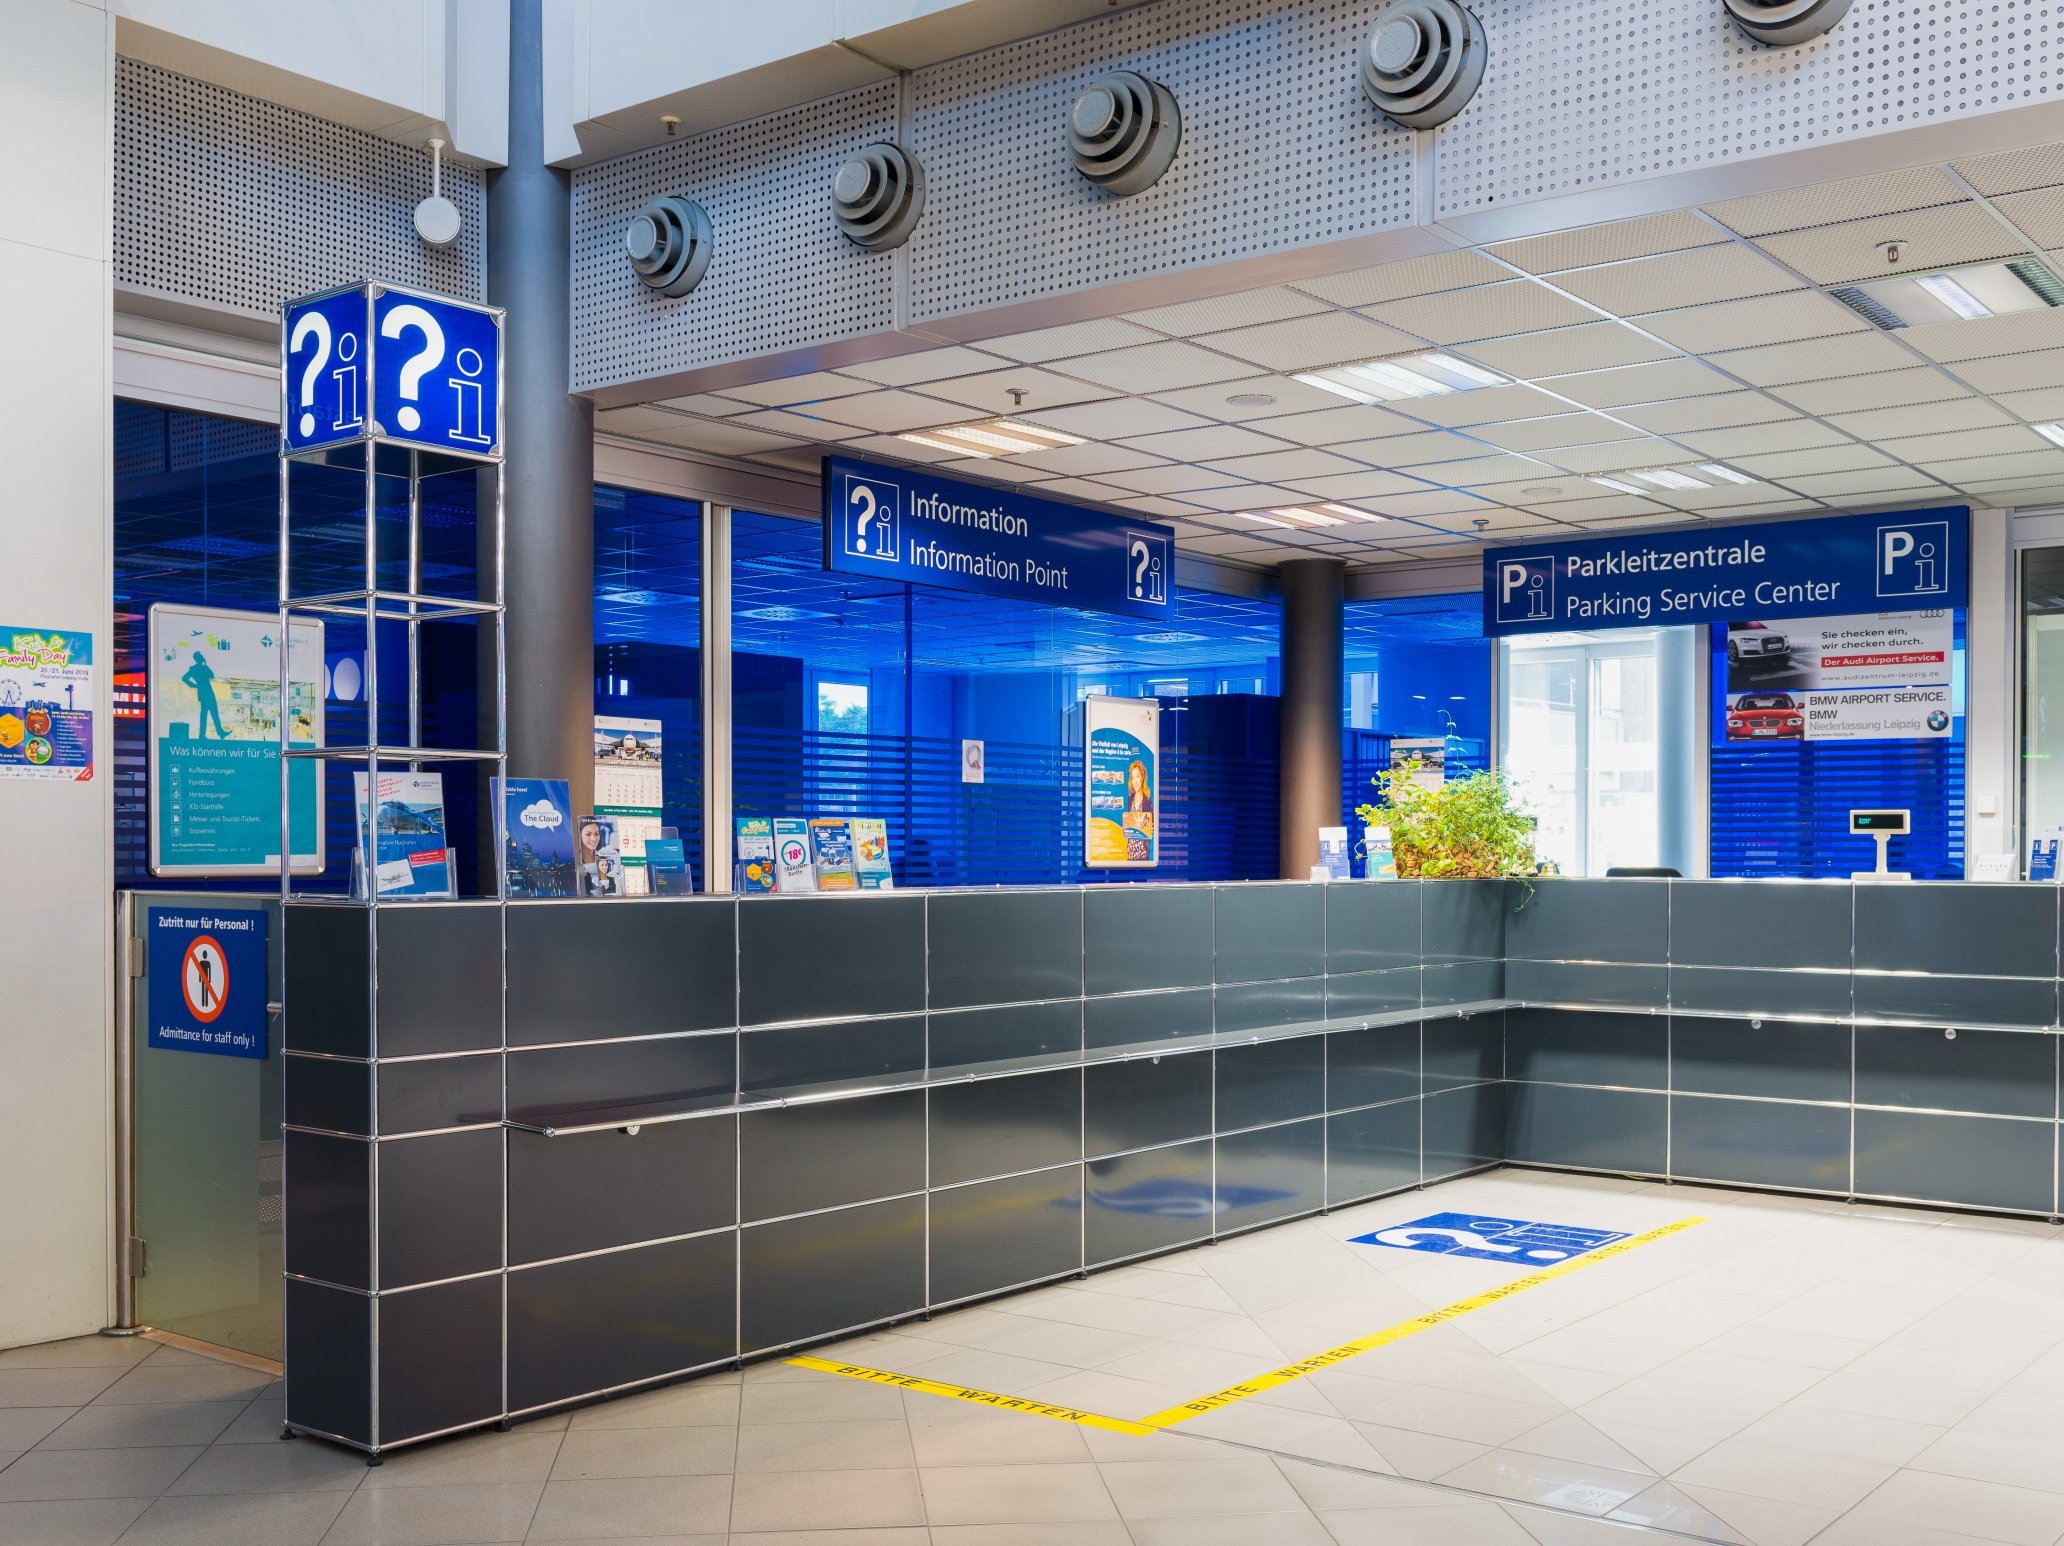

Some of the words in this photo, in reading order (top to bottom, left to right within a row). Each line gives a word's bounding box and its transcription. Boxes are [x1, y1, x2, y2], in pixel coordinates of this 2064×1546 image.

[911, 490, 1028, 537] Information
[910, 539, 1018, 581] Information
[1026, 558, 1068, 589] Point
[1567, 540, 1766, 578] Parkleitzentrale
[1567, 590, 1650, 620] Parking
[1660, 586, 1746, 613] Service
[1755, 578, 1840, 604] Center
[1840, 630, 1884, 638] checken
[1888, 628, 1908, 636] ein,
[1841, 640, 1885, 649] checken
[1888, 638, 1924, 646] durch.
[37, 648, 66, 664] Day
[1842, 657, 1864, 665] Audi
[1866, 656, 1900, 665] Airport
[1902, 654, 1939, 662] Service.
[1822, 671, 1939, 680] www.audizentrum-leipzig.de
[1810, 696, 1838, 706] BMW
[1840, 694, 1891, 704] AIRPORT
[1894, 692, 1946, 702] SERVICE.
[1810, 710, 1838, 720] BMW
[1810, 720, 1880, 732] Niederlassung
[1884, 719, 1920, 730] Leipzig
[170, 746, 190, 756] Was
[192, 746, 226, 758] können
[230, 748, 244, 758] wir
[247, 748, 260, 758] für
[263, 748, 276, 759] Sie
[188, 767, 236, 775] Aufbewahrungen
[158, 916, 184, 928] Zutritt
[186, 919, 199, 928] nur
[201, 917, 212, 929] für
[214, 918, 248, 930] Personal
[159, 1026, 200, 1041] Admittance
[202, 1030, 212, 1042] for
[214, 1030, 232, 1044] staff
[233, 1034, 250, 1049] only
[1185, 1385, 1259, 1411] BITTE
[1273, 1346, 1362, 1378] WARTEN
[1418, 1304, 1472, 1325] BITTE
[1480, 1274, 1548, 1300] WARTEN
[1587, 1244, 1632, 1260] BITTE
[1633, 1222, 1687, 1242] WARTEN
[836, 1366, 924, 1386] BITTE
[958, 1390, 1088, 1421] WARTEN
